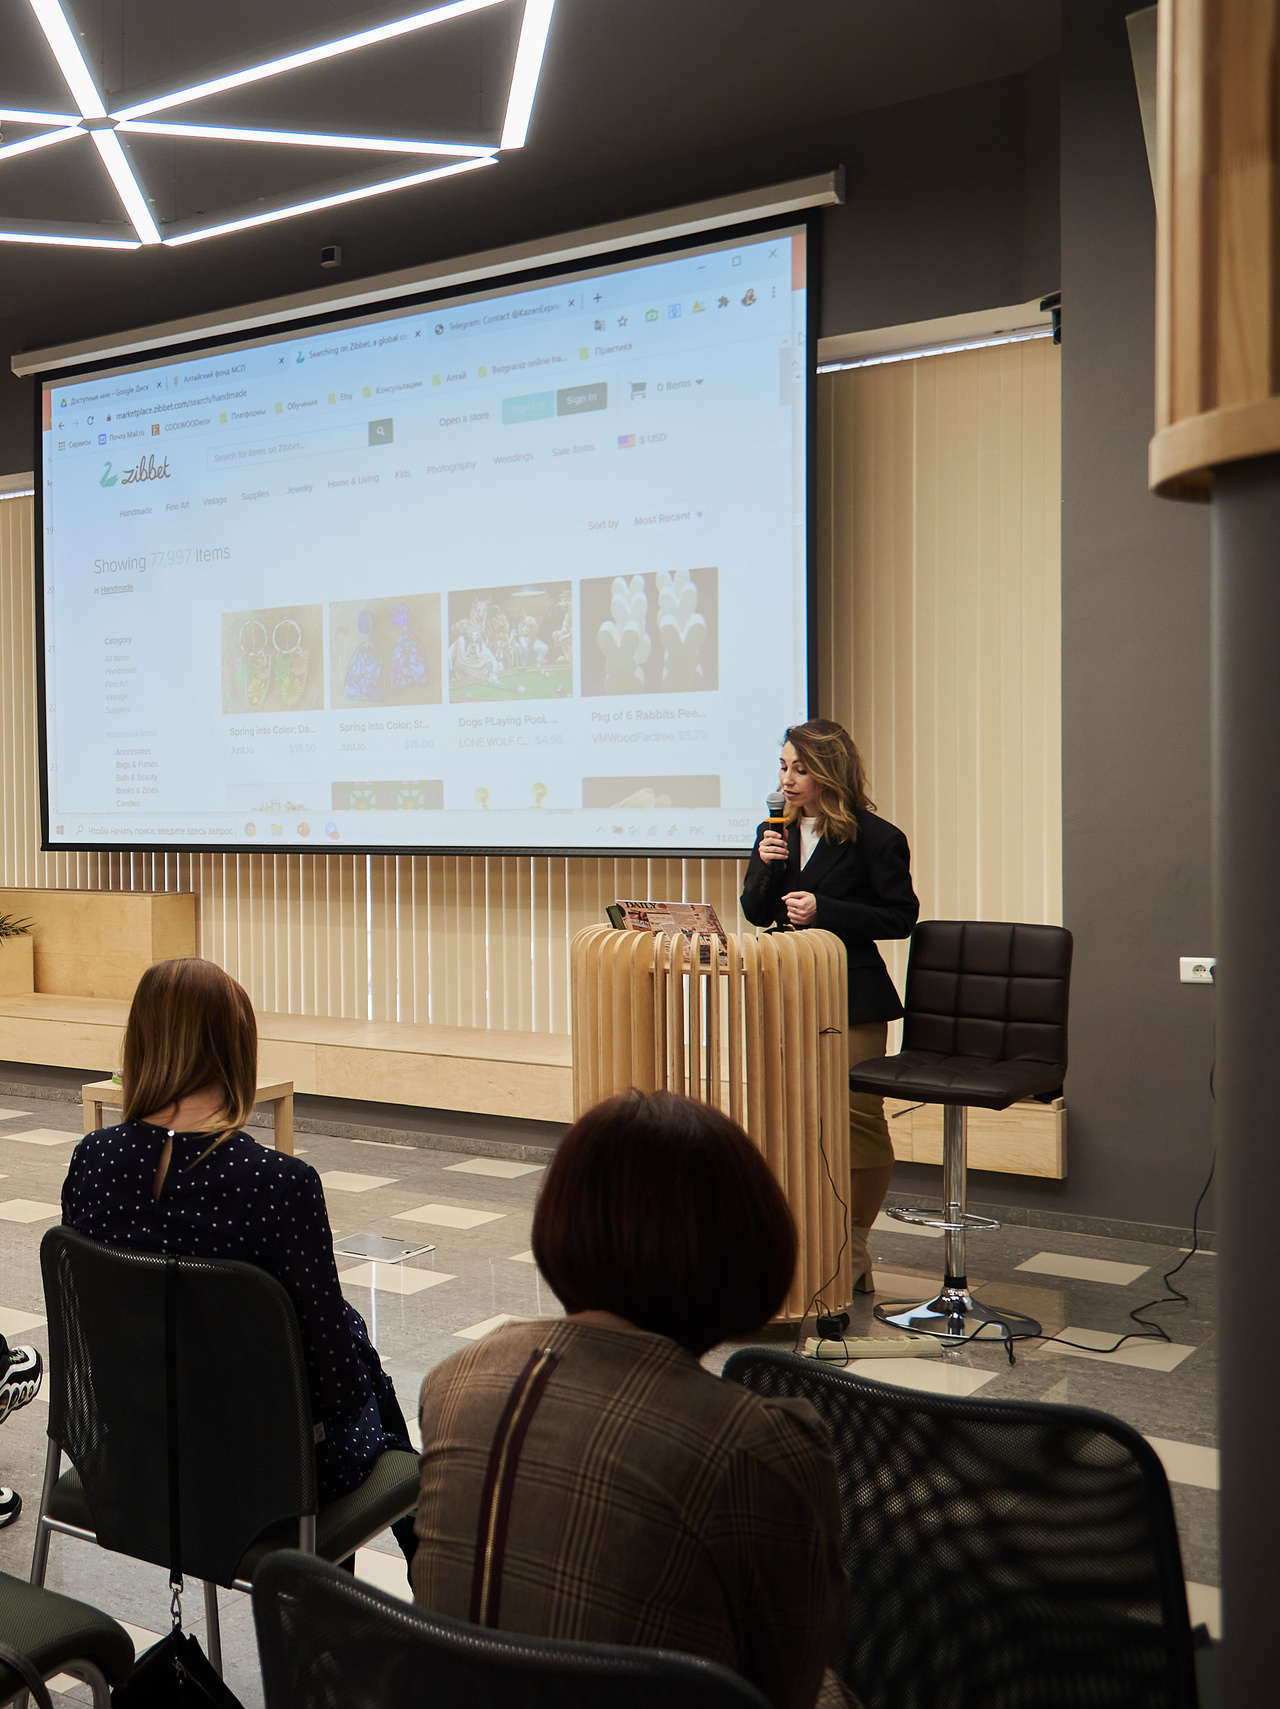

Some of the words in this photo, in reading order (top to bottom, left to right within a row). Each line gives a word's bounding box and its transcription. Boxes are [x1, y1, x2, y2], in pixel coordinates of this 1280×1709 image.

[483, 312, 510, 324] Contact
[308, 346, 338, 359] Searching
[340, 345, 348, 353] on
[378, 333, 398, 347] global
[595, 343, 633, 356] Практика
[527, 357, 550, 368] online
[184, 370, 213, 383] Алтайский
[214, 368, 230, 378] фонд
[231, 364, 246, 373] МСП
[446, 371, 467, 382] Алтай
[376, 381, 422, 394] Консультации
[666, 380, 692, 390] Items
[70, 394, 99, 406] Доступные
[99, 392, 111, 400] мне
[115, 387, 135, 398] Google
[135, 385, 149, 394] Диск
[340, 392, 353, 402] Etsy
[566, 393, 587, 406] Sign
[588, 392, 597, 400] In
[116, 389, 248, 420] marketplace.zibbet.com/search/handmade
[287, 399, 318, 411] Обучение
[231, 409, 266, 420] Платформы
[439, 417, 461, 427] Open
[470, 411, 490, 421] store
[109, 433, 126, 442] Почта
[127, 430, 145, 439] Mail.ru
[639, 435, 645, 445] $
[647, 432, 667, 444] USD
[68, 440, 91, 449] Сервисы
[214, 452, 237, 462] Search
[238, 450, 247, 458] for
[248, 447, 266, 457] items
[268, 446, 276, 454] on
[552, 447, 570, 457] Sale
[493, 452, 534, 465] Weddings
[121, 453, 171, 485] zibbet
[427, 460, 477, 475] Photography
[395, 470, 411, 479] Kids
[327, 479, 349, 489] Home
[350, 477, 356, 485] &
[358, 474, 379, 485] Living
[286, 484, 313, 495] Jewelry
[202, 496, 227, 506] Vintage
[242, 490, 270, 501] Supplies
[120, 506, 153, 517] Handmade
[166, 503, 179, 512] Fine
[180, 501, 190, 510] Art
[634, 515, 657, 526] Most
[658, 511, 691, 523] Recent
[588, 520, 606, 531] Sort
[608, 519, 620, 530] by
[94, 556, 146, 575] Showing
[150, 548, 192, 568] 77,997
[195, 547, 231, 563] Items
[94, 586, 100, 594] in
[101, 583, 134, 594] Handmade
[104, 637, 132, 646] Category
[104, 655, 112, 663] All
[105, 667, 138, 675] Handmade
[105, 680, 118, 688] Fine
[119, 680, 128, 688] Art
[105, 693, 129, 702] Vintage
[105, 706, 131, 715] Supplies
[591, 711, 610, 723] Pkg
[613, 710, 624, 721] of
[626, 711, 633, 720] 6
[636, 709, 675, 720] Rabbits
[339, 722, 366, 733] Spring
[368, 721, 384, 731] into
[459, 717, 483, 729] Dogs
[485, 715, 521, 727] PLaying
[524, 714, 548, 724] PooL
[229, 727, 254, 738] Spring
[256, 726, 271, 735] into
[591, 731, 674, 744] VMWoodFactree
[459, 737, 484, 748] LONE
[486, 736, 514, 747] WOLF
[115, 747, 151, 756] Accessories
[115, 761, 130, 770] Bags
[138, 760, 158, 768] Purses
[115, 774, 129, 782] Bath
[137, 773, 158, 782] Beauty
[116, 786, 135, 795] Books
[142, 786, 159, 794] Zines
[116, 800, 141, 808] Candles
[728, 819, 750, 828] 10:07
[88, 827, 108, 835] Чтобы
[110, 827, 133, 835] начать
[134, 827, 156, 836] поиск,
[158, 828, 185, 836] введите
[186, 828, 207, 836] здесь
[208, 828, 234, 837] запрос
[689, 826, 705, 835] РУС
[716, 834, 756, 843] 11.03.202
